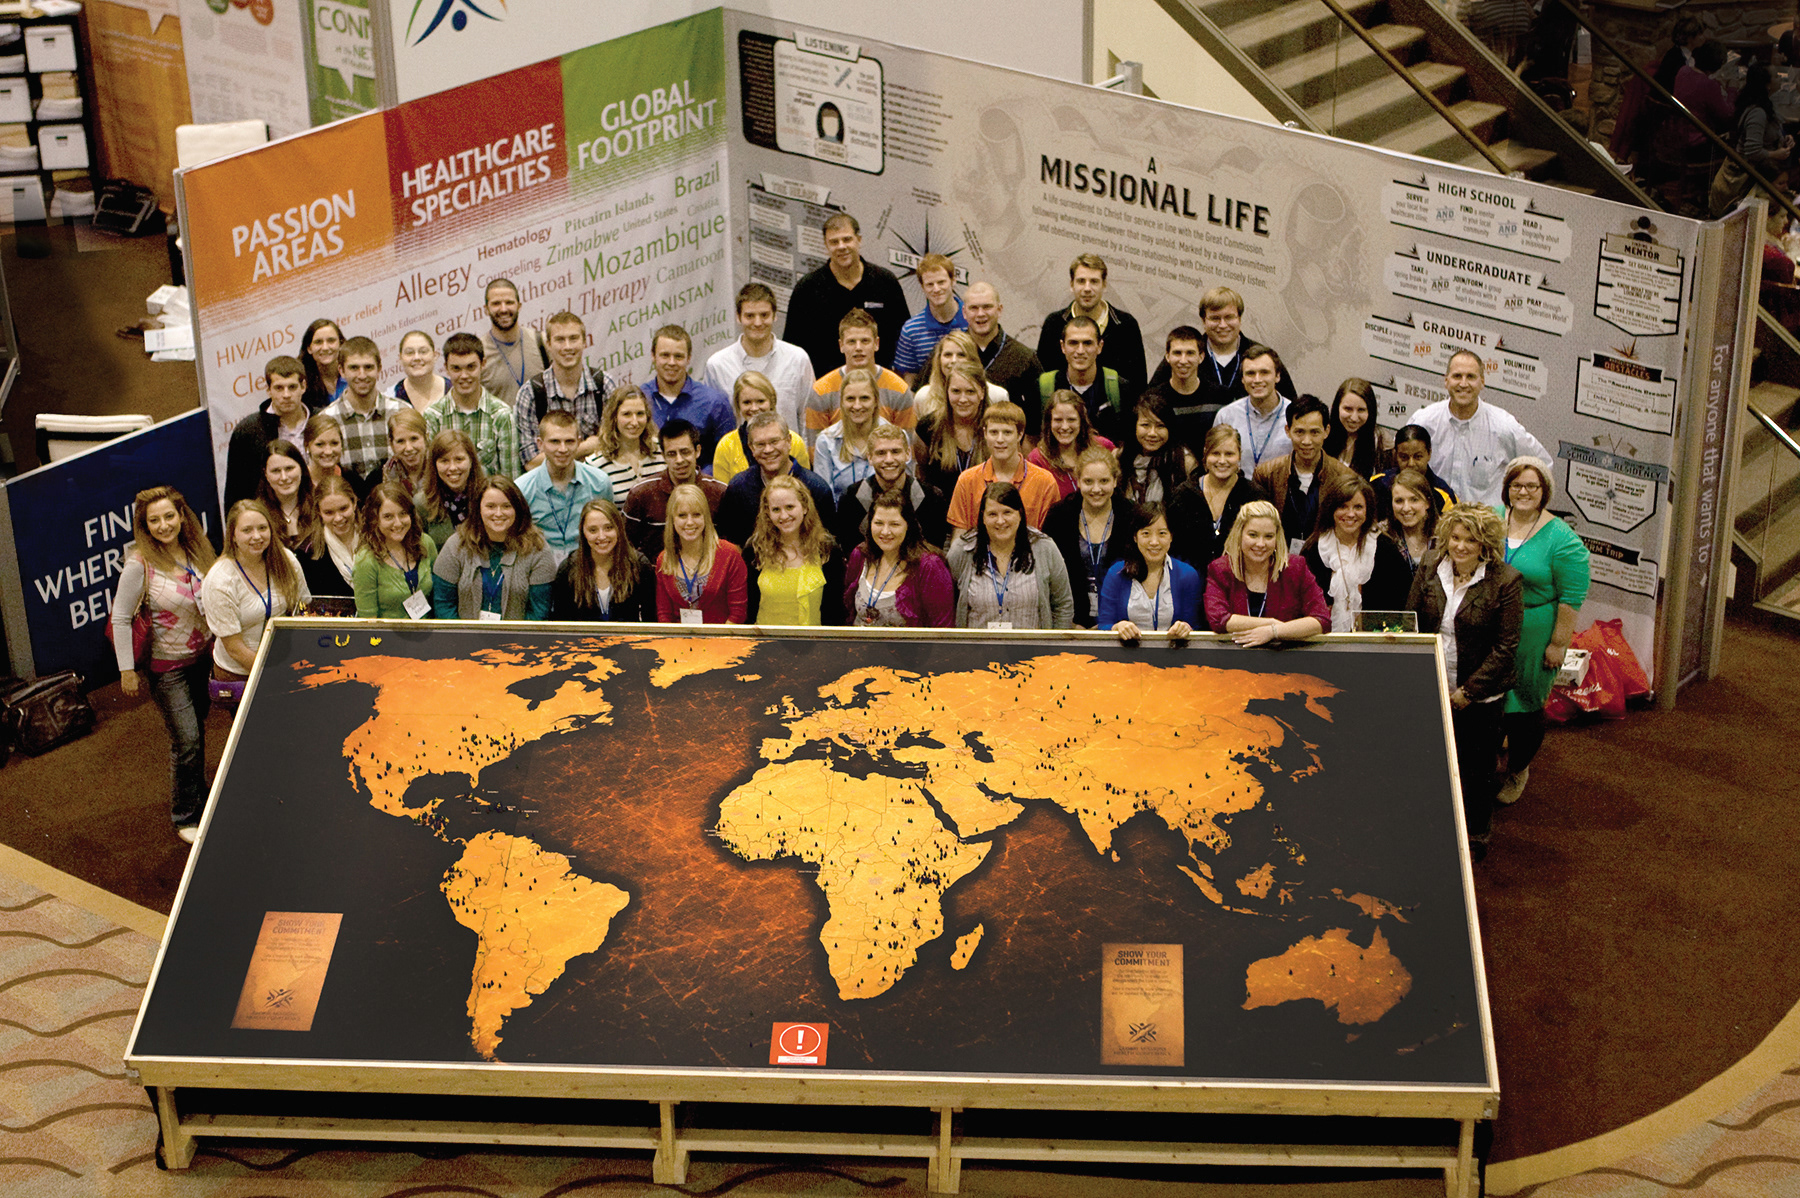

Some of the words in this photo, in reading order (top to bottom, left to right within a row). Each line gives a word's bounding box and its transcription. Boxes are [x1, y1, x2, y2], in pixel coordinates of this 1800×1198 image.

[805, 37, 849, 55] LISTENING
[601, 80, 695, 131] GLOBAL
[578, 99, 717, 170] FOOTPRINT
[402, 123, 556, 198] HEALTHCARE
[1148, 157, 1157, 174] A
[411, 155, 550, 226] SPECIALTIES
[675, 161, 720, 198] Brazil
[1041, 154, 1197, 220] MISSIONAL
[1207, 194, 1271, 237] LIFE
[1406, 192, 1423, 203] SERVE
[1438, 182, 1466, 198] HIGH
[1470, 189, 1516, 209] SCHOOL
[565, 209, 611, 234] Pitcairn
[615, 192, 654, 215] Islands
[623, 214, 651, 232] United
[654, 206, 678, 221] States
[1436, 210, 1454, 219] AND
[1460, 204, 1474, 214] FIND
[232, 189, 356, 257] PASSION
[1499, 224, 1517, 234] AND
[1523, 219, 1538, 229] READ
[477, 227, 551, 261] Hematology
[547, 227, 619, 266] Zimbabwe
[584, 215, 725, 285] Mozambique
[1205, 231, 1222, 245] Great
[252, 225, 344, 283] AREAS
[895, 252, 914, 265] LIFE
[1179, 241, 1202, 256] Marked
[1236, 257, 1276, 275] commitment
[1624, 245, 1660, 260] MENTOR
[477, 258, 541, 288] Counseling
[657, 248, 724, 285] Camaroon
[1195, 260, 1214, 275] Christ
[1411, 264, 1424, 274] TAKE
[1426, 250, 1531, 286] UNDERGRADUATE
[395, 264, 471, 308] Allergy
[579, 275, 650, 317] Therapy
[1431, 281, 1450, 289] AND
[355, 300, 382, 321] relief
[607, 280, 715, 336] AFGHANISTAN
[1504, 299, 1523, 308] AND
[1526, 297, 1542, 308] PRAY
[371, 322, 397, 340] Health
[399, 309, 438, 330] Education
[1365, 322, 1388, 335] DISCIPLE
[1423, 320, 1487, 346] GRADUATE
[217, 324, 295, 368] HIV/AIDS
[703, 329, 734, 347] NEPAL
[1414, 344, 1432, 354] AND
[1504, 358, 1536, 373] VOLUNTEER
[1604, 361, 1650, 380] OBSTACLES
[1713, 344, 1729, 373] For
[233, 372, 269, 397] Cle
[1404, 383, 1447, 402] RESIDE
[1389, 405, 1406, 414] AND
[1704, 379, 1721, 444] anyone
[1567, 450, 1598, 464] SCHOOL
[1702, 447, 1719, 484] that
[1614, 462, 1661, 479] RESIDENCY
[85, 502, 135, 548] FIN
[1699, 487, 1714, 538] wants
[1607, 547, 1624, 559] TRIP
[1698, 546, 1709, 563] to
[272, 926, 327, 935] COMMITMENT
[1114, 958, 1170, 966] COMMITMENT
